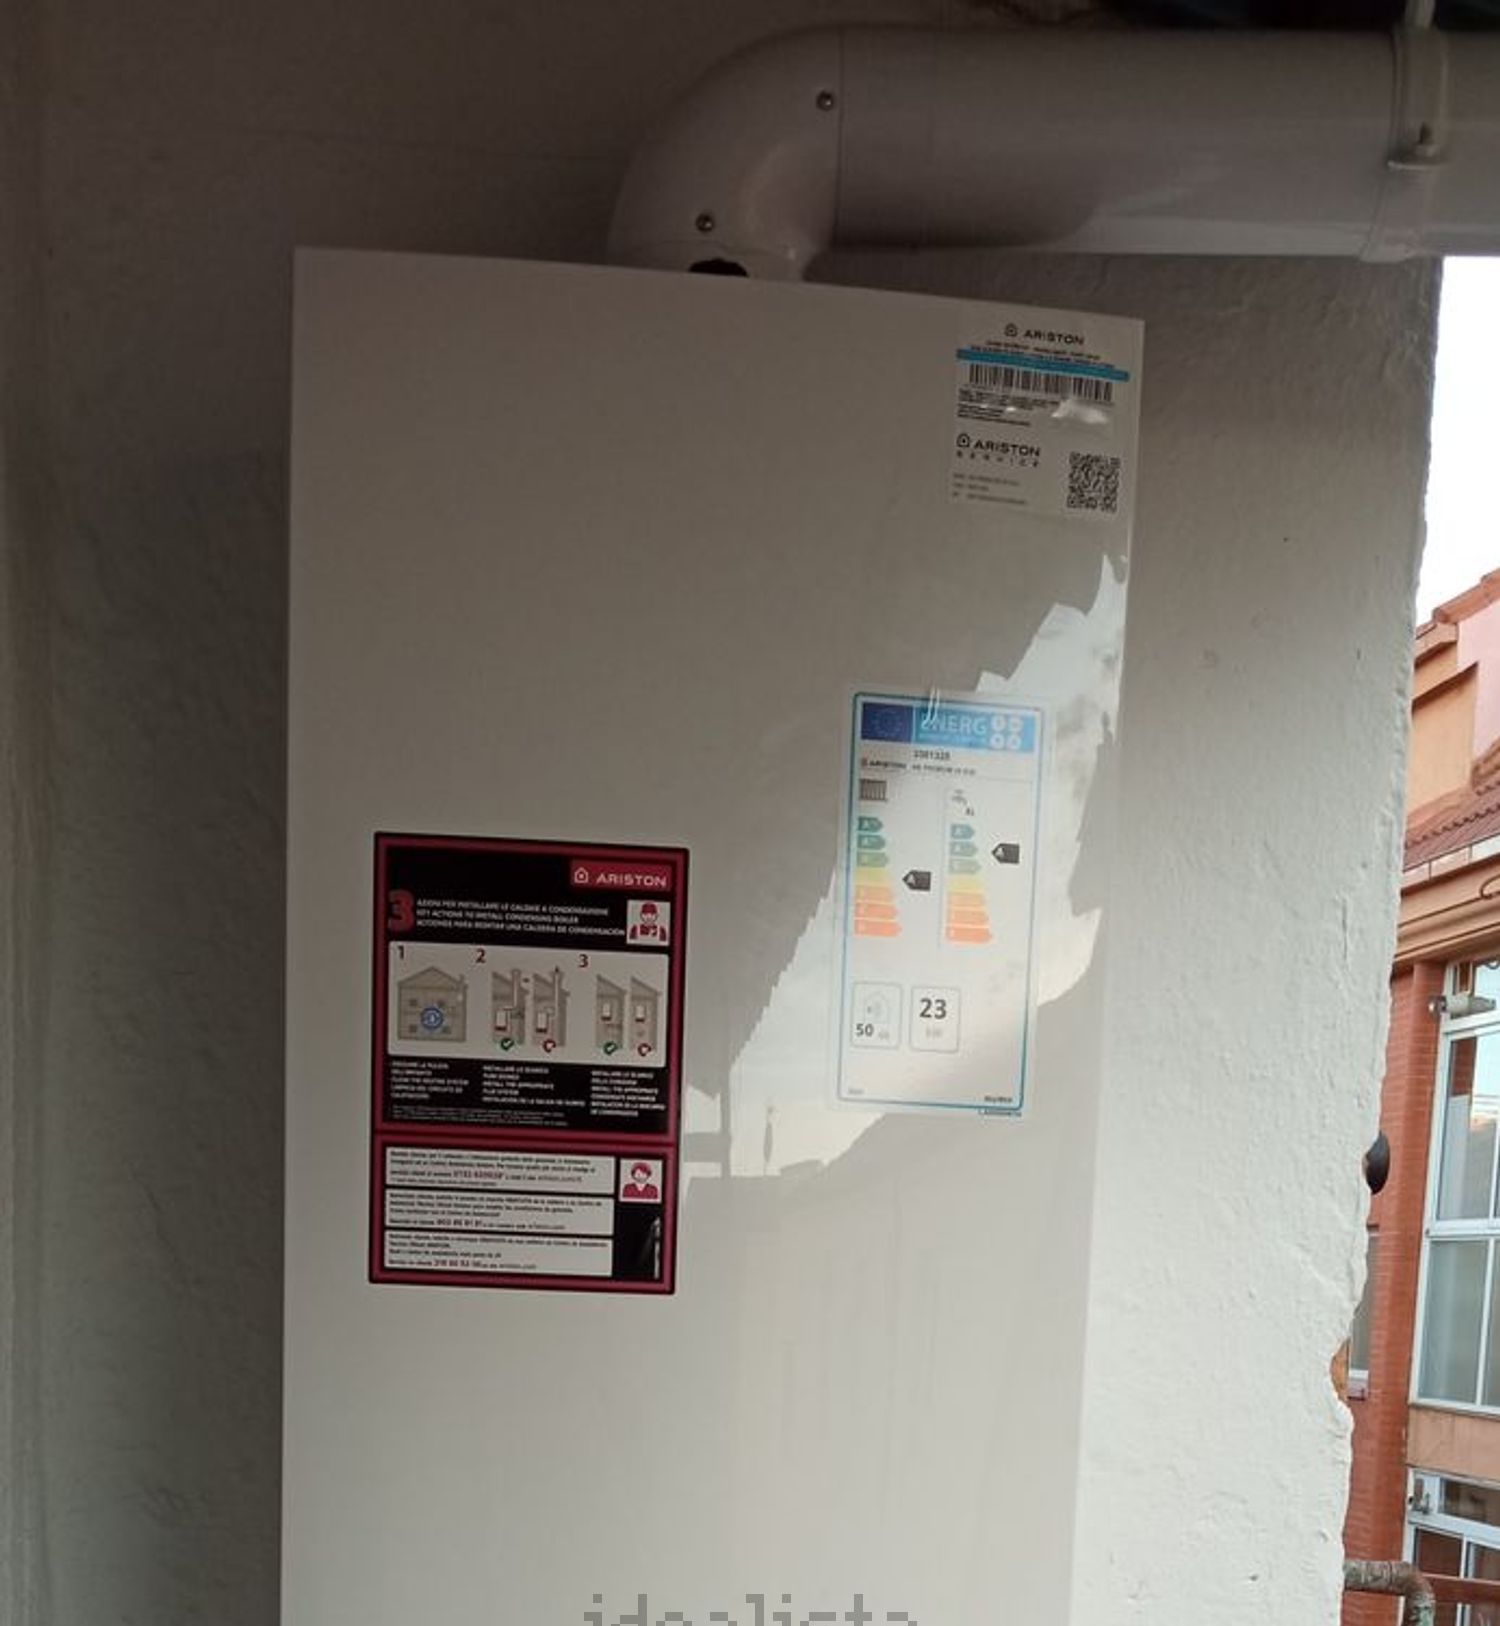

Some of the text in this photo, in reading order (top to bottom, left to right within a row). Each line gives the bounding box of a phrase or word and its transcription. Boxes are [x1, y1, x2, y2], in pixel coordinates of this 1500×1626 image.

[1024, 329, 1084, 346] ARISTON
[974, 439, 1041, 457] ARISTON
[596, 872, 667, 888] ARISTON
[387, 888, 415, 933] 3
[397, 945, 405, 960] 1
[475, 948, 486, 964] 2
[577, 954, 589, 968] 3
[918, 998, 948, 1020] 23
[855, 1023, 875, 1037] 50
